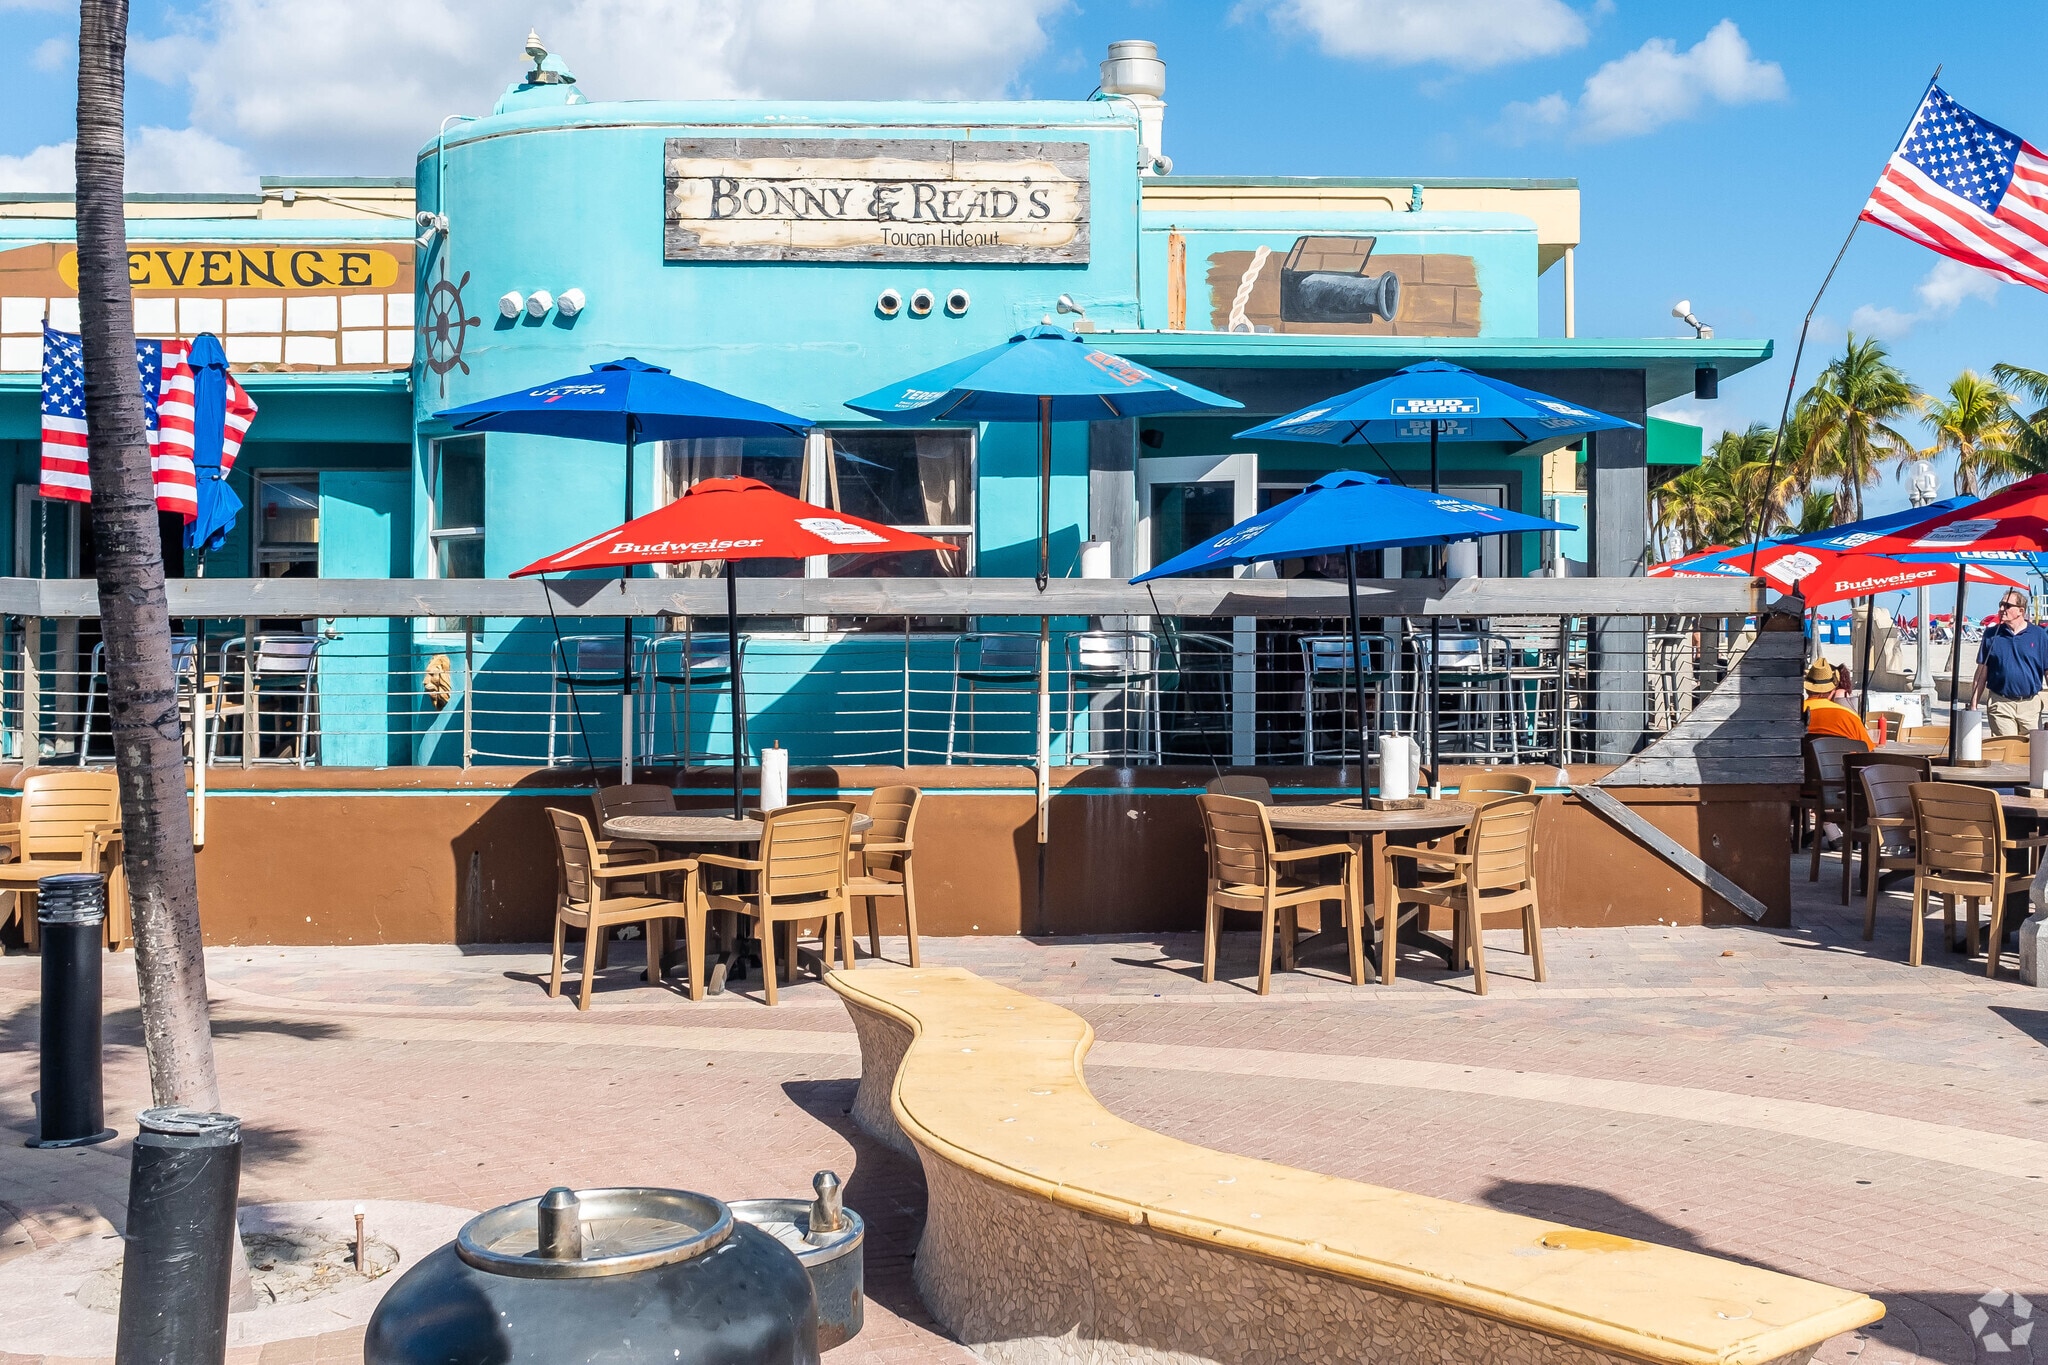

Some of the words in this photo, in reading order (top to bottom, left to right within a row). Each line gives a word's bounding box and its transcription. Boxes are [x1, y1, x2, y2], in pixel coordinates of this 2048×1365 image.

[710, 178, 853, 221] BONNY
[867, 185, 904, 222] &
[912, 179, 1051, 224] READ'S
[880, 227, 936, 247] Toucan
[128, 249, 372, 287] EVENGE
[529, 387, 606, 397] ULTRA
[1396, 405, 1474, 413] LIGHT
[1408, 399, 1463, 407] BUD
[609, 538, 764, 555] Budweiser
[1834, 569, 1937, 592] Budweiser
